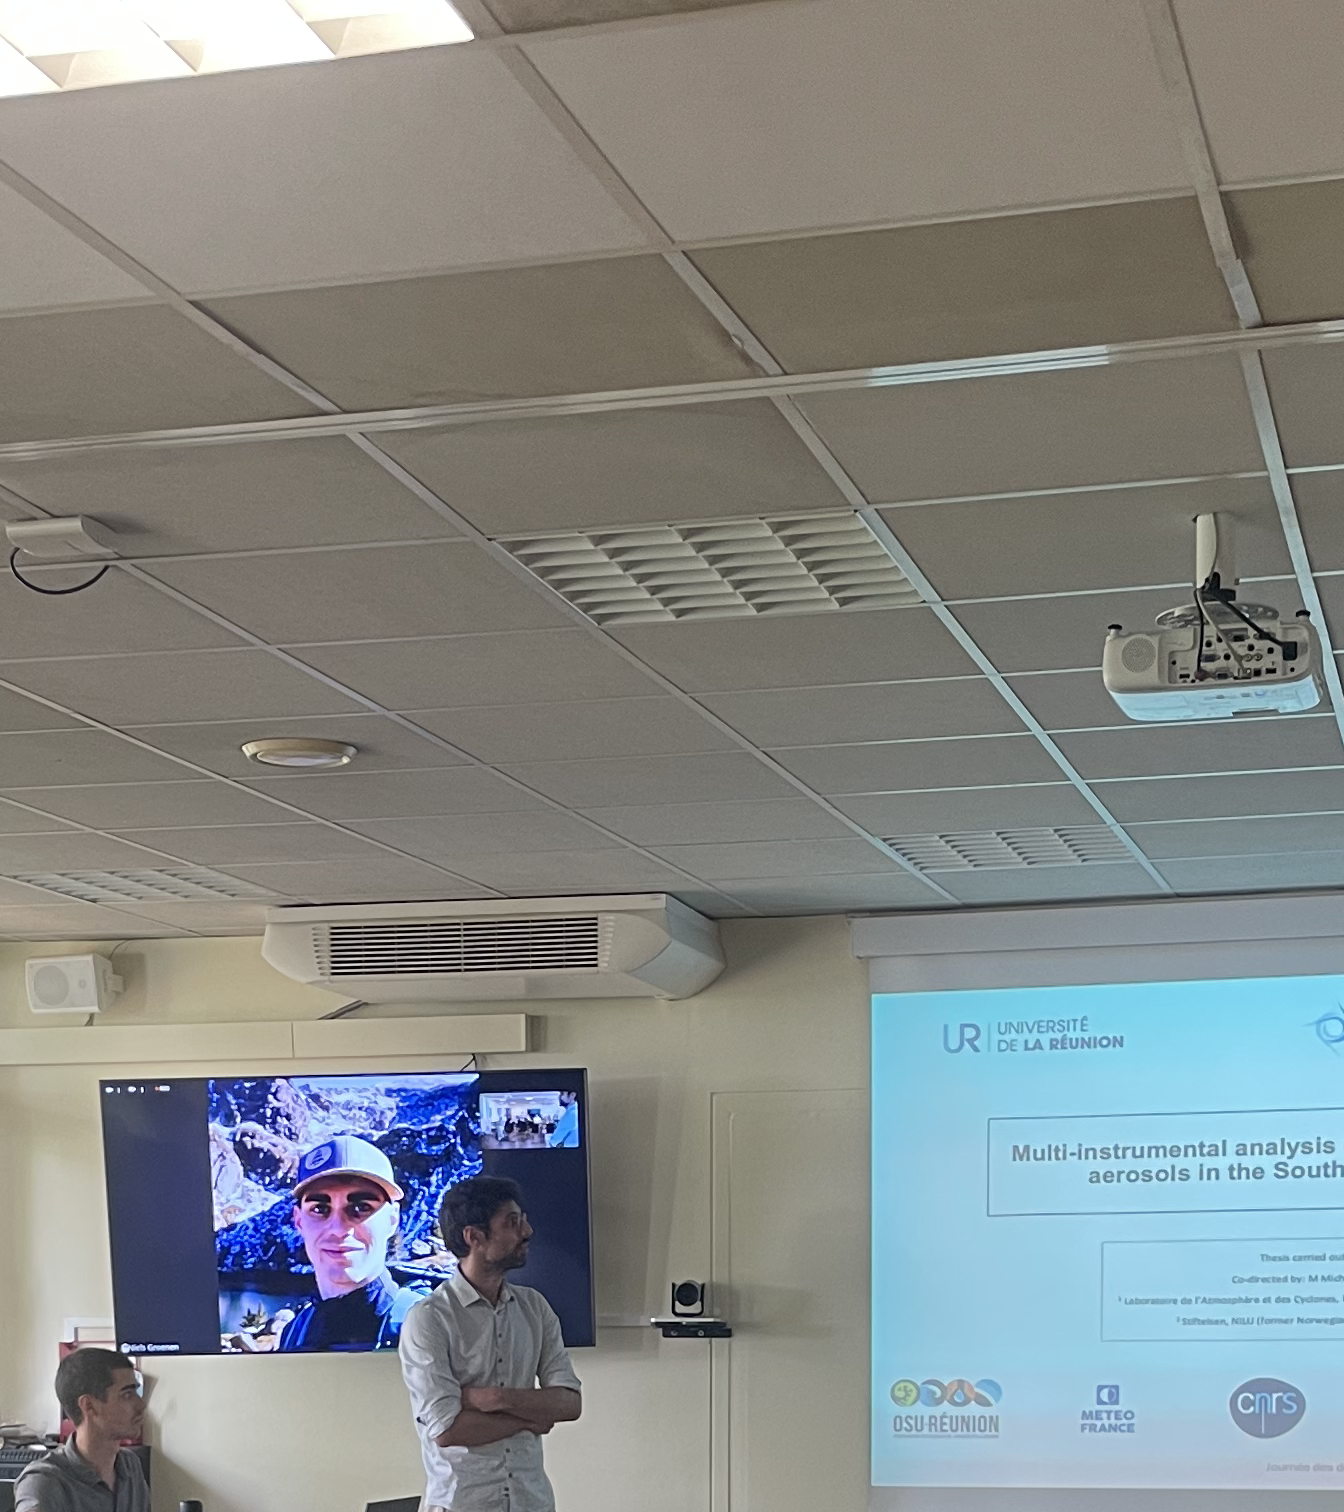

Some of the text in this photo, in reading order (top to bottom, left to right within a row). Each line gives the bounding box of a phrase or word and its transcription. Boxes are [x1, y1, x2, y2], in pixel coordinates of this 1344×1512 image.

[997, 1015, 1089, 1035] UNIVERSITÉ
[943, 1023, 982, 1054] UR
[997, 1033, 1124, 1053] DE LA RÉUNION
[1011, 1139, 1228, 1163] Multi-instrumental
[1234, 1136, 1336, 1161] analysis
[1087, 1163, 1191, 1185] aerosols
[1198, 1163, 1220, 1181] in
[1227, 1161, 1266, 1181] the
[1307, 1274, 1319, 1283] M
[1080, 1408, 1136, 1422] METEO
[1080, 1422, 1136, 1435] FRANCE
